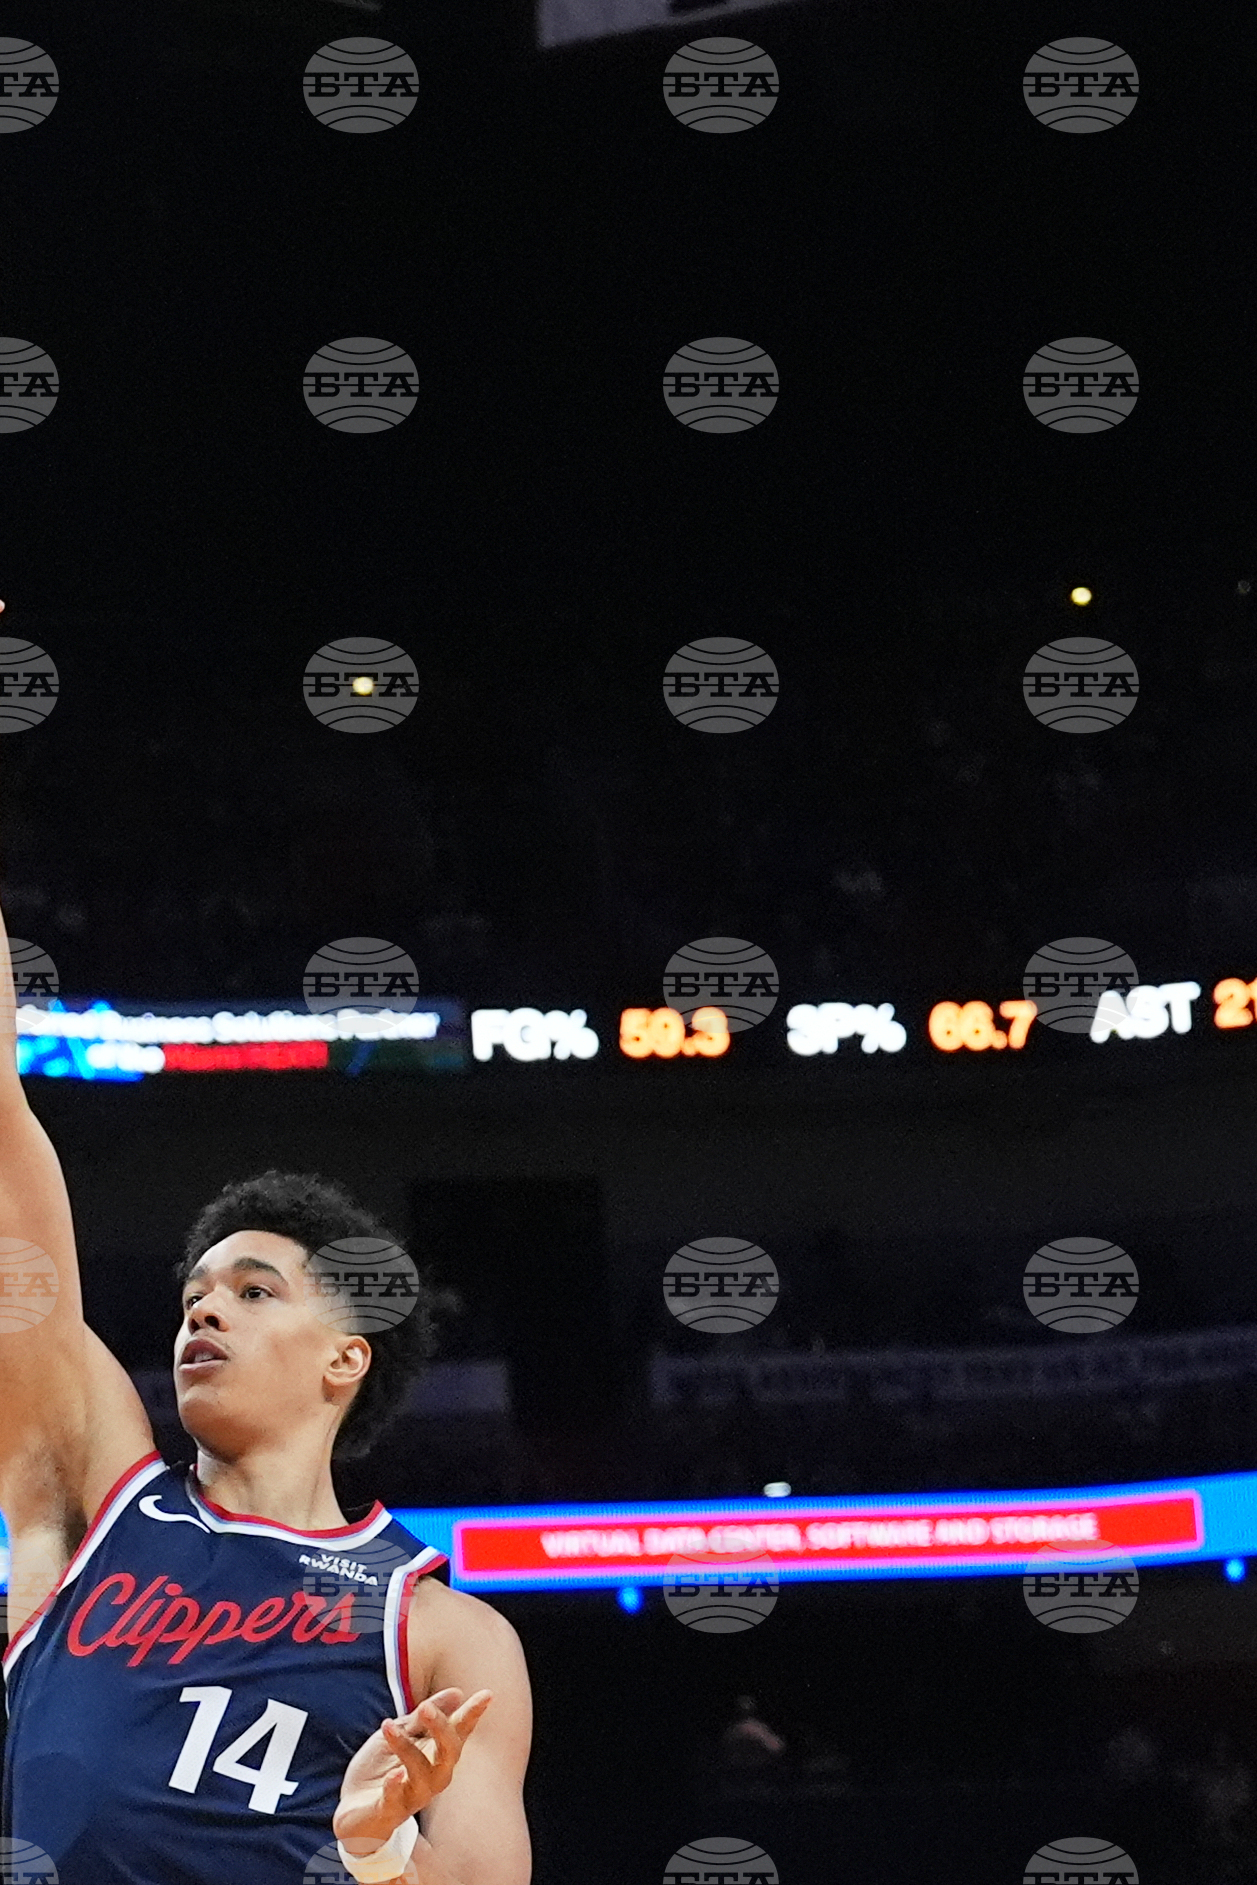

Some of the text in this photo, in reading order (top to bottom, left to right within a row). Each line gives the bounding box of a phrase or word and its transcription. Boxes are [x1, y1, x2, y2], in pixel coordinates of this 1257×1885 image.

[1090, 981, 1201, 1044] AST
[299, 1554, 378, 1586] RWANDA
[321, 1554, 367, 1573] VISIT
[66, 1572, 364, 1667] Clippers
[168, 1685, 309, 1815] 14
